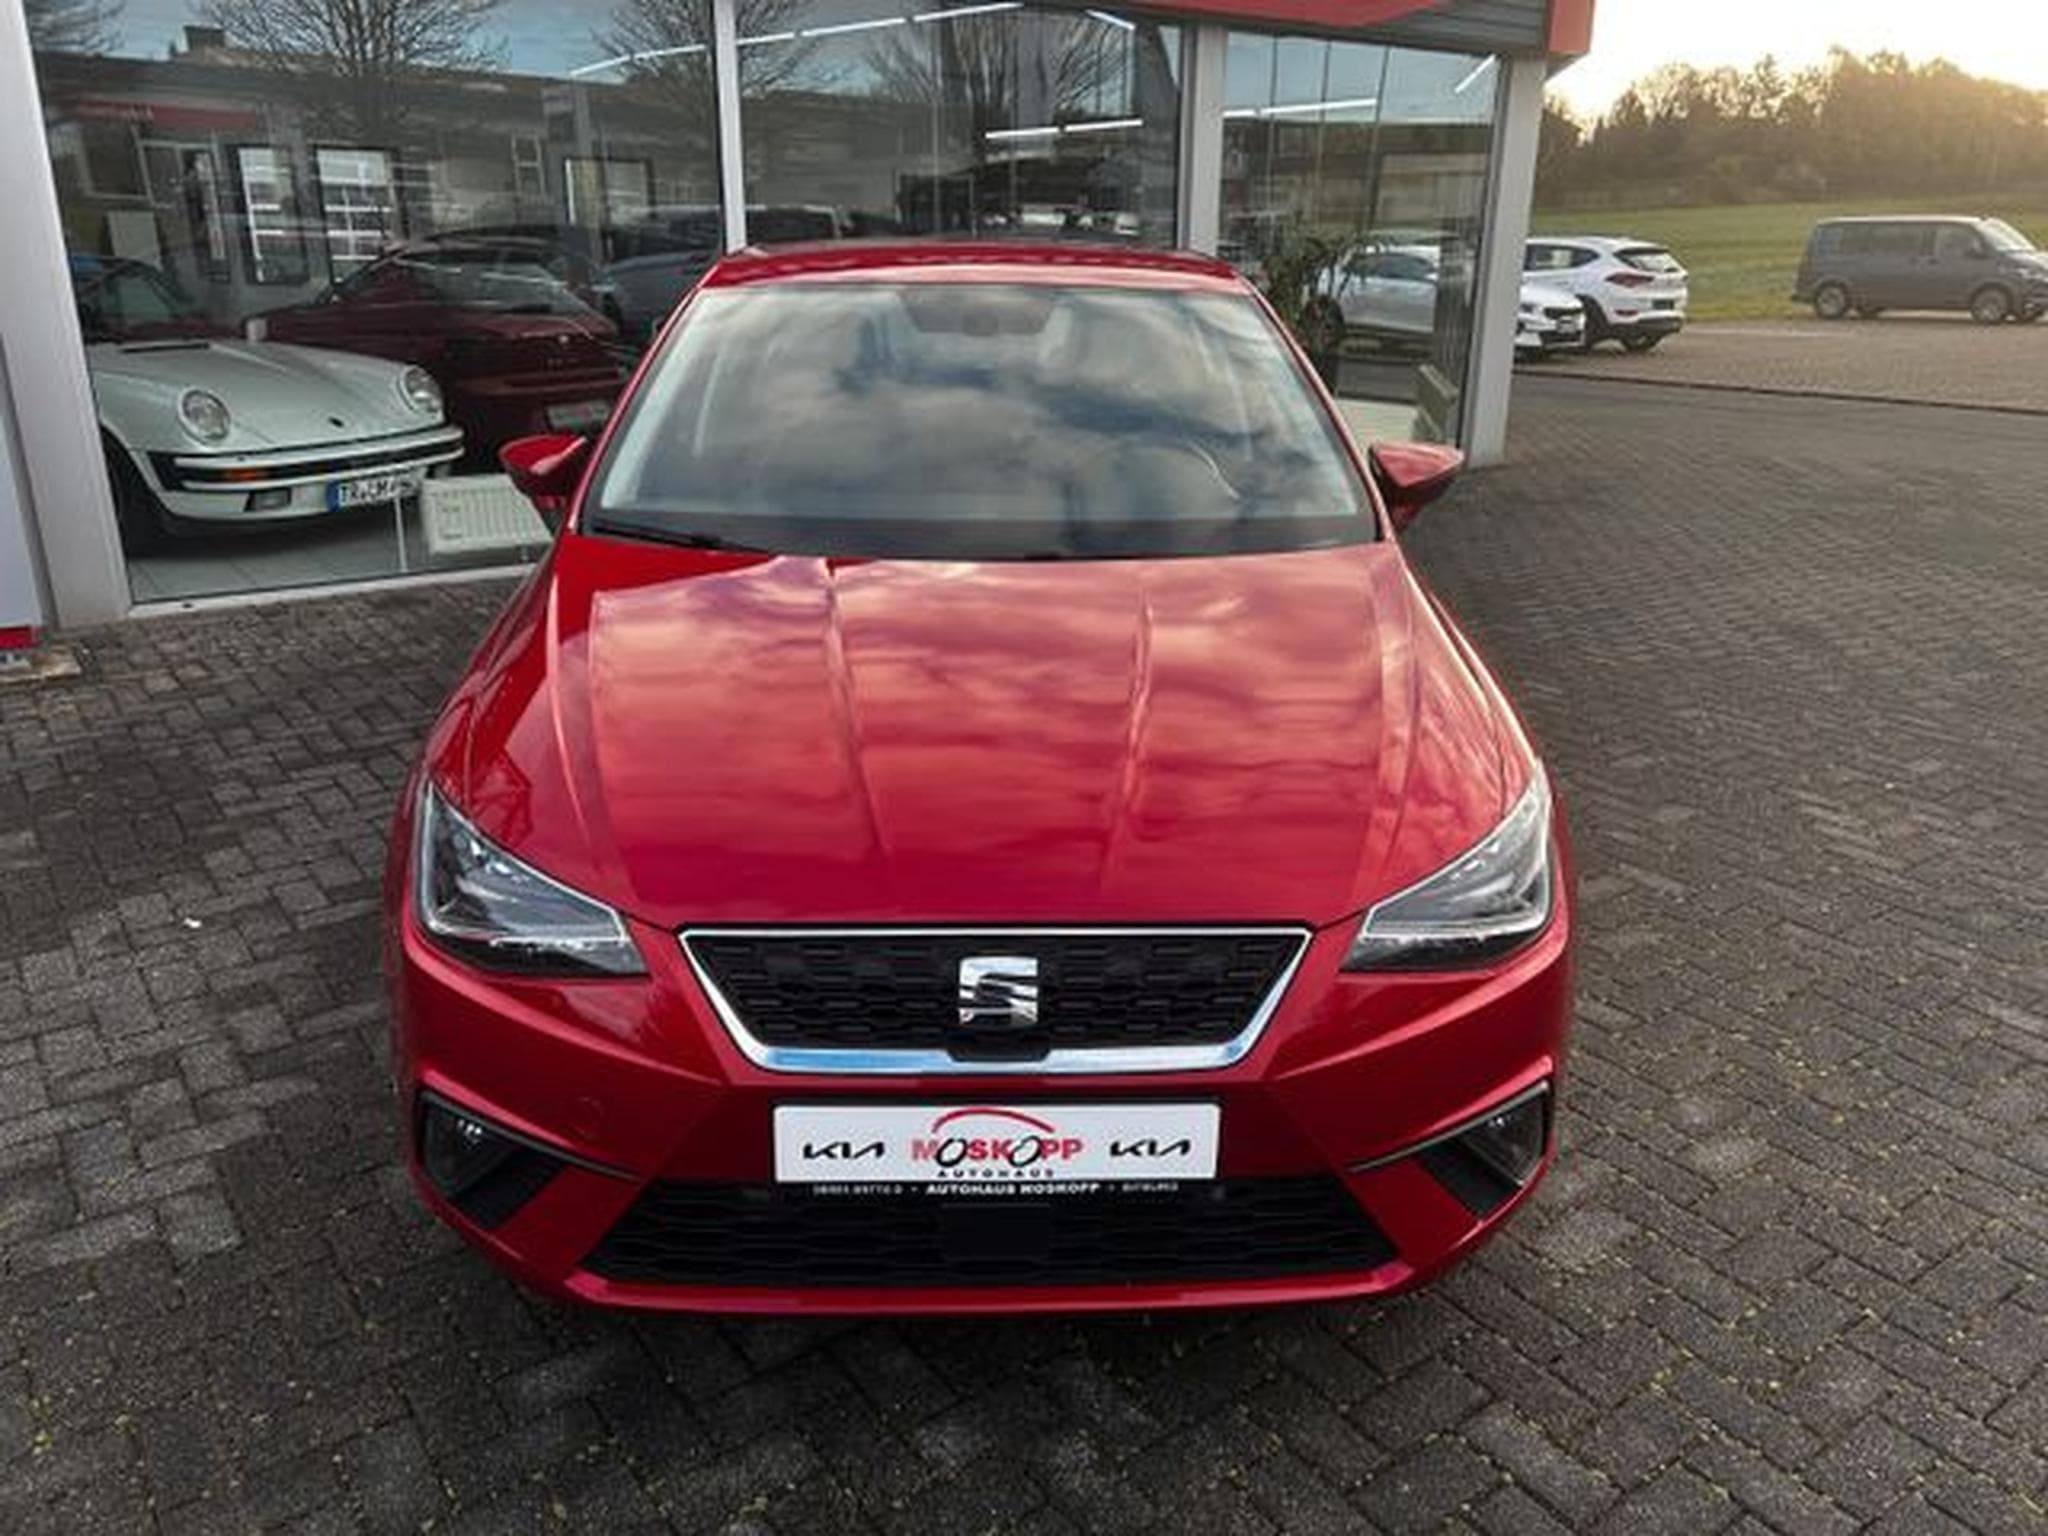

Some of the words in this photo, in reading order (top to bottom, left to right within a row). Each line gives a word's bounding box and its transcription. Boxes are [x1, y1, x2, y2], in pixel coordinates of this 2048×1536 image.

[803, 1142, 885, 1160] KIA
[911, 1135, 1084, 1168] MOSKOPP
[1109, 1140, 1191, 1158] KIA
[937, 1169, 1054, 1178] AUTOHAUS
[926, 1183, 1016, 1195] AUTOHAUS
[1020, 1182, 1100, 1195] MOSKOPP
